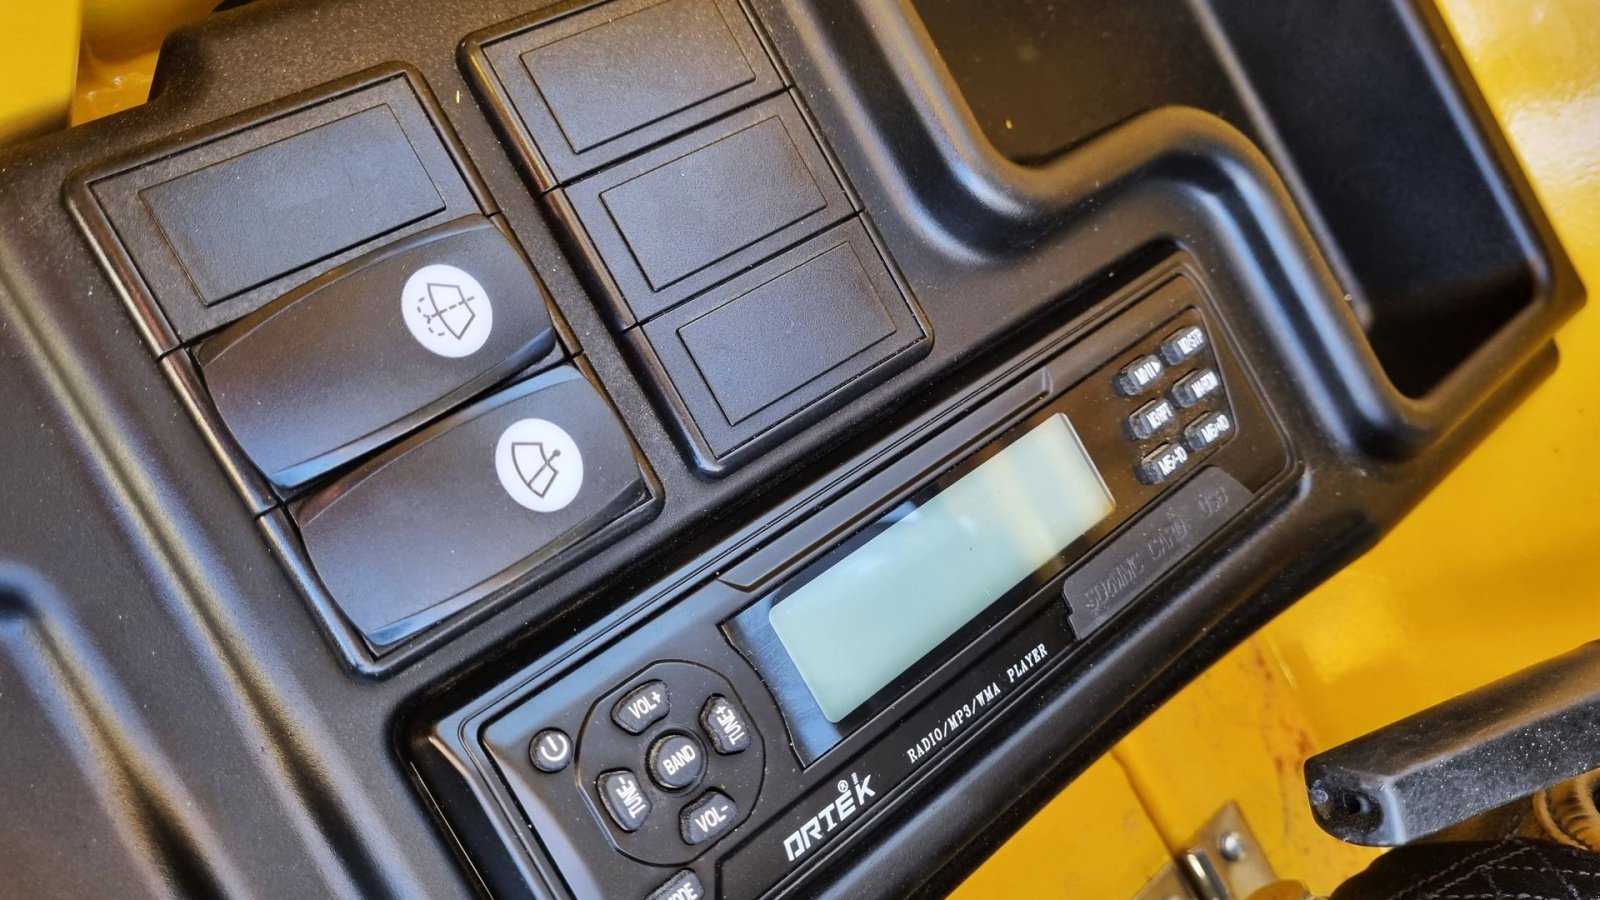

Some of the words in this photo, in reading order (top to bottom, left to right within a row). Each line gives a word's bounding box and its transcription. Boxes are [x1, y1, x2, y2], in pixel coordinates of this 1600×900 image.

[628, 691, 661, 721] VOL+
[906, 681, 1001, 764] RADIO/MP3/WMA
[1006, 643, 1048, 683] PLAYER
[716, 705, 742, 745] TUNE+
[663, 744, 696, 775] BAND
[615, 777, 647, 819] TUNE-
[695, 805, 729, 834] VOL-
